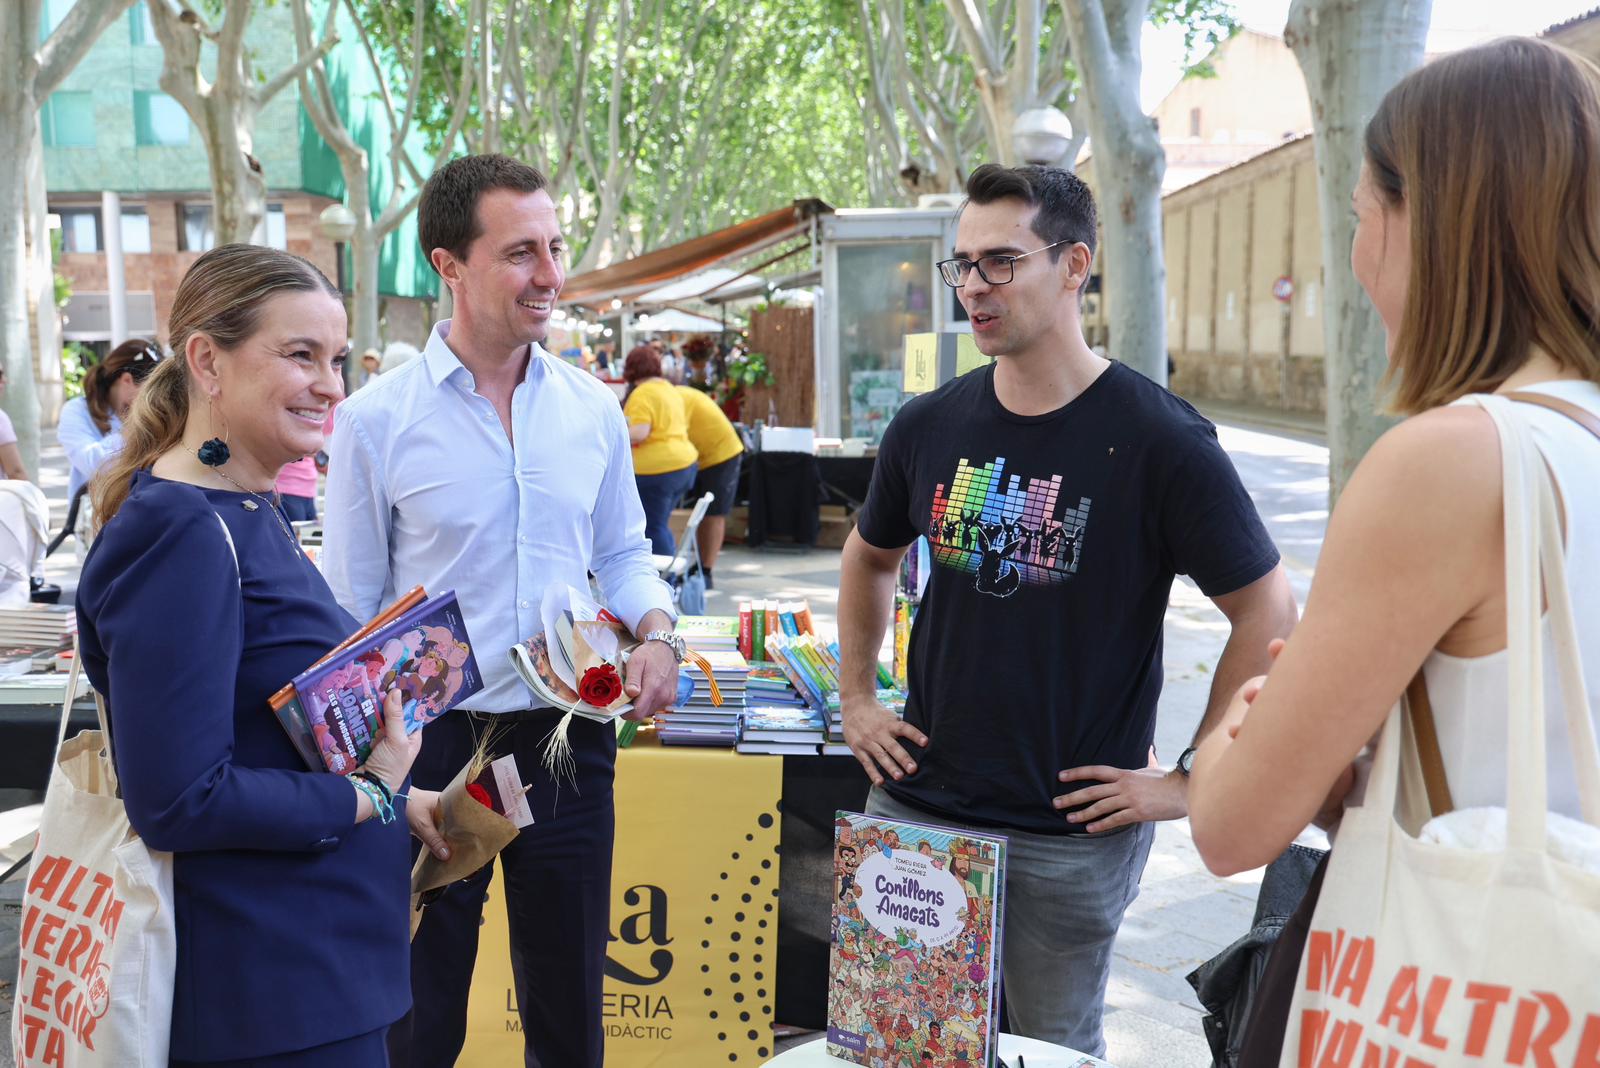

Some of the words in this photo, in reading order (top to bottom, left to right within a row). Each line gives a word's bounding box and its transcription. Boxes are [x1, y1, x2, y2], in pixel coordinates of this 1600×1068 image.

[338, 688, 371, 747] JOANET
[361, 699, 375, 717] EN
[328, 693, 338, 707] ELS
[333, 706, 343, 720] SET
[338, 720, 357, 758] MISSATGES
[875, 874, 944, 907] Conillons
[876, 895, 940, 928] Amagats
[603, 1023, 673, 1040] IDÀCTIC
